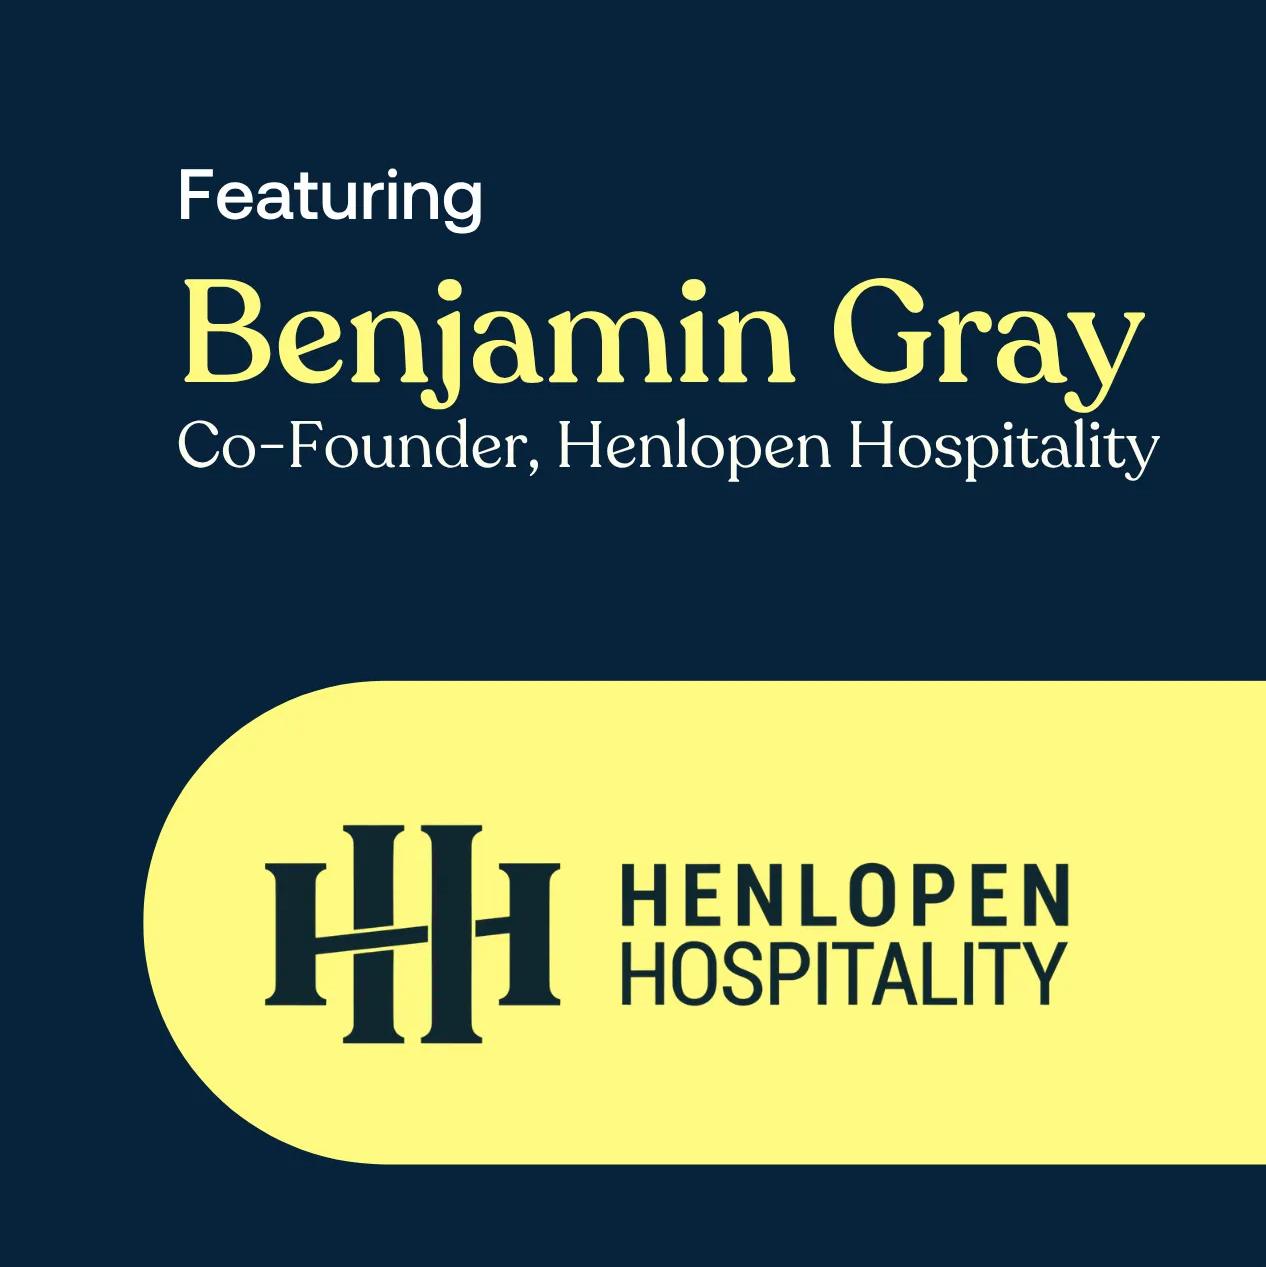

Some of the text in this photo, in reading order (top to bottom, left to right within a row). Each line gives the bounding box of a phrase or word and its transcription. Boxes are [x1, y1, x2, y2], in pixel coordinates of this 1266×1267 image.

[180, 168, 483, 234] Featuring
[184, 278, 1146, 413] Benjamin Gray
[178, 418, 1161, 483] Co-Founder, Henlopen Hospitality
[622, 863, 1071, 928] HENLOPEN
[622, 941, 1069, 1007] HOSPITALITY
